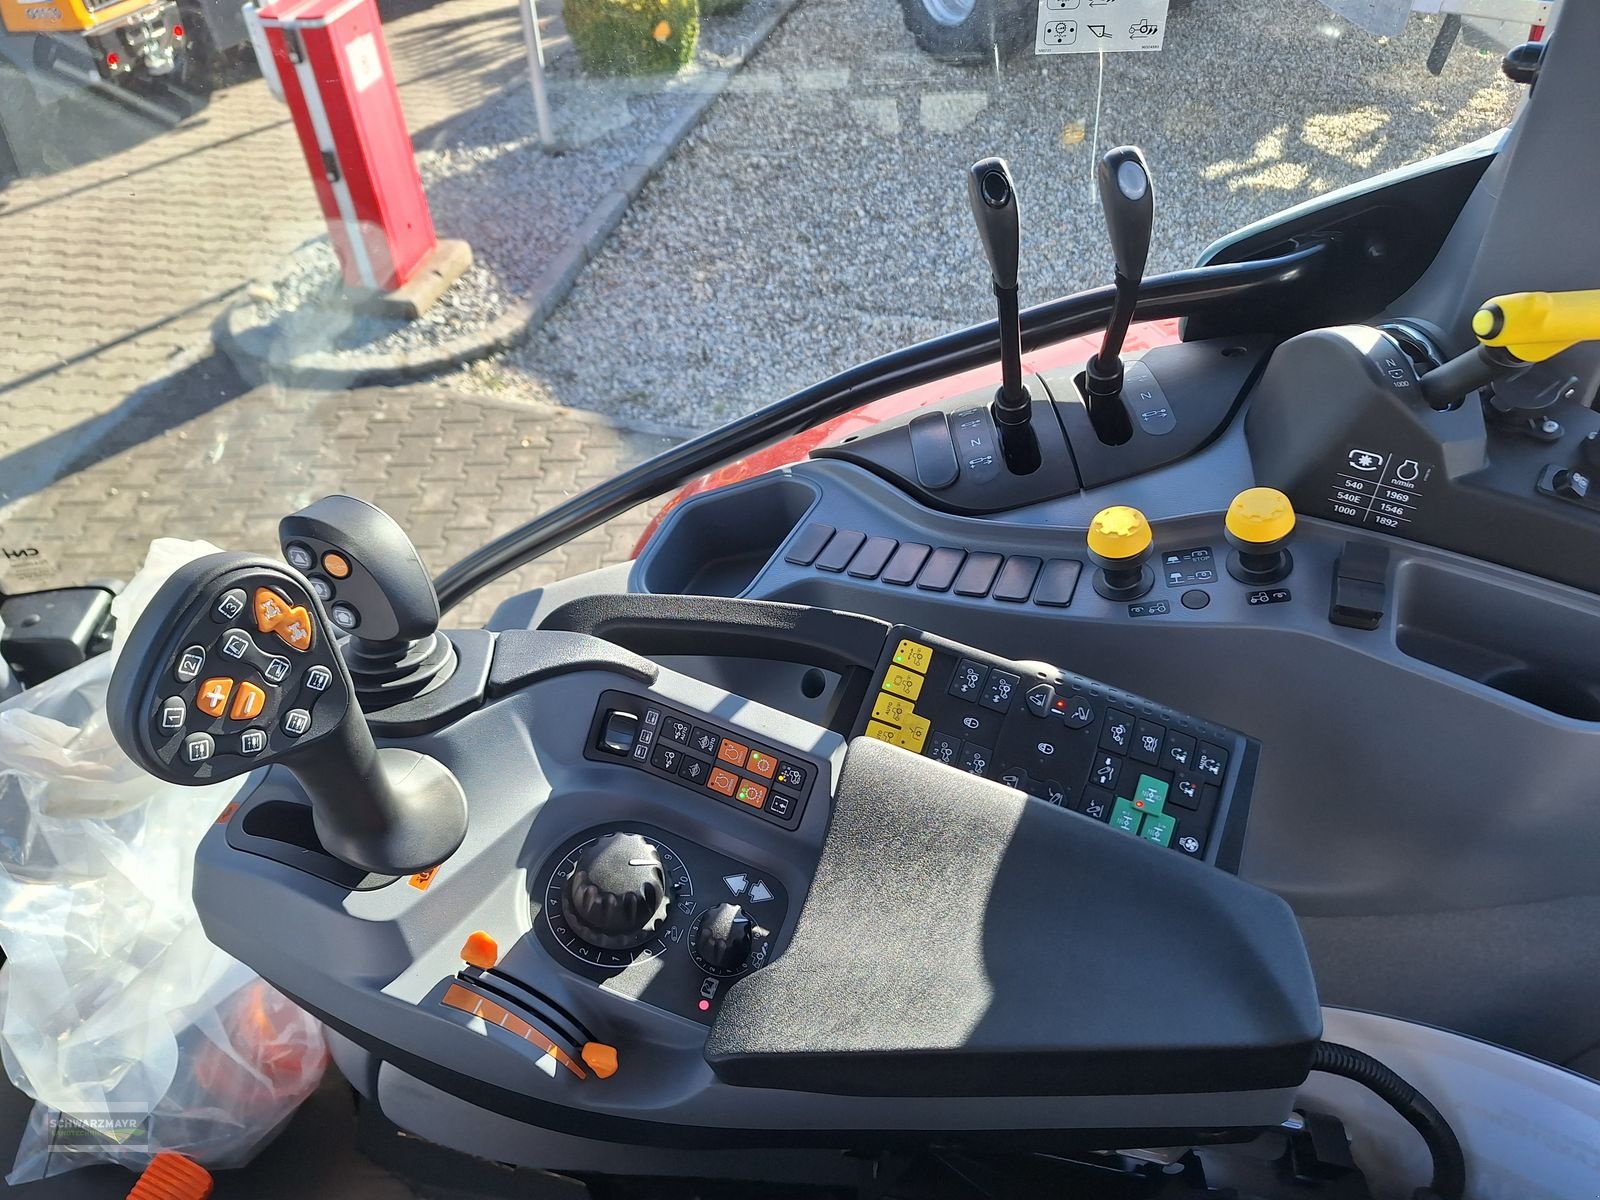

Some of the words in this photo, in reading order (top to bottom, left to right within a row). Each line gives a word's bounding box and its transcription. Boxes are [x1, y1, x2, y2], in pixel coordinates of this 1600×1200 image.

[1393, 380, 1410, 388] 1000
[1344, 479, 1364, 490] 540
[1385, 490, 1410, 502] 1969
[1391, 478, 1415, 489] n/min
[1336, 491, 1362, 504] 540E
[1380, 503, 1404, 516] 1546
[1333, 504, 1356, 516] 1000
[1375, 516, 1398, 528] 1892
[1192, 554, 1210, 563] STOP
[680, 726, 688, 741] AUTO
[708, 737, 716, 752] AUTO
[1198, 754, 1207, 771] AUTO
